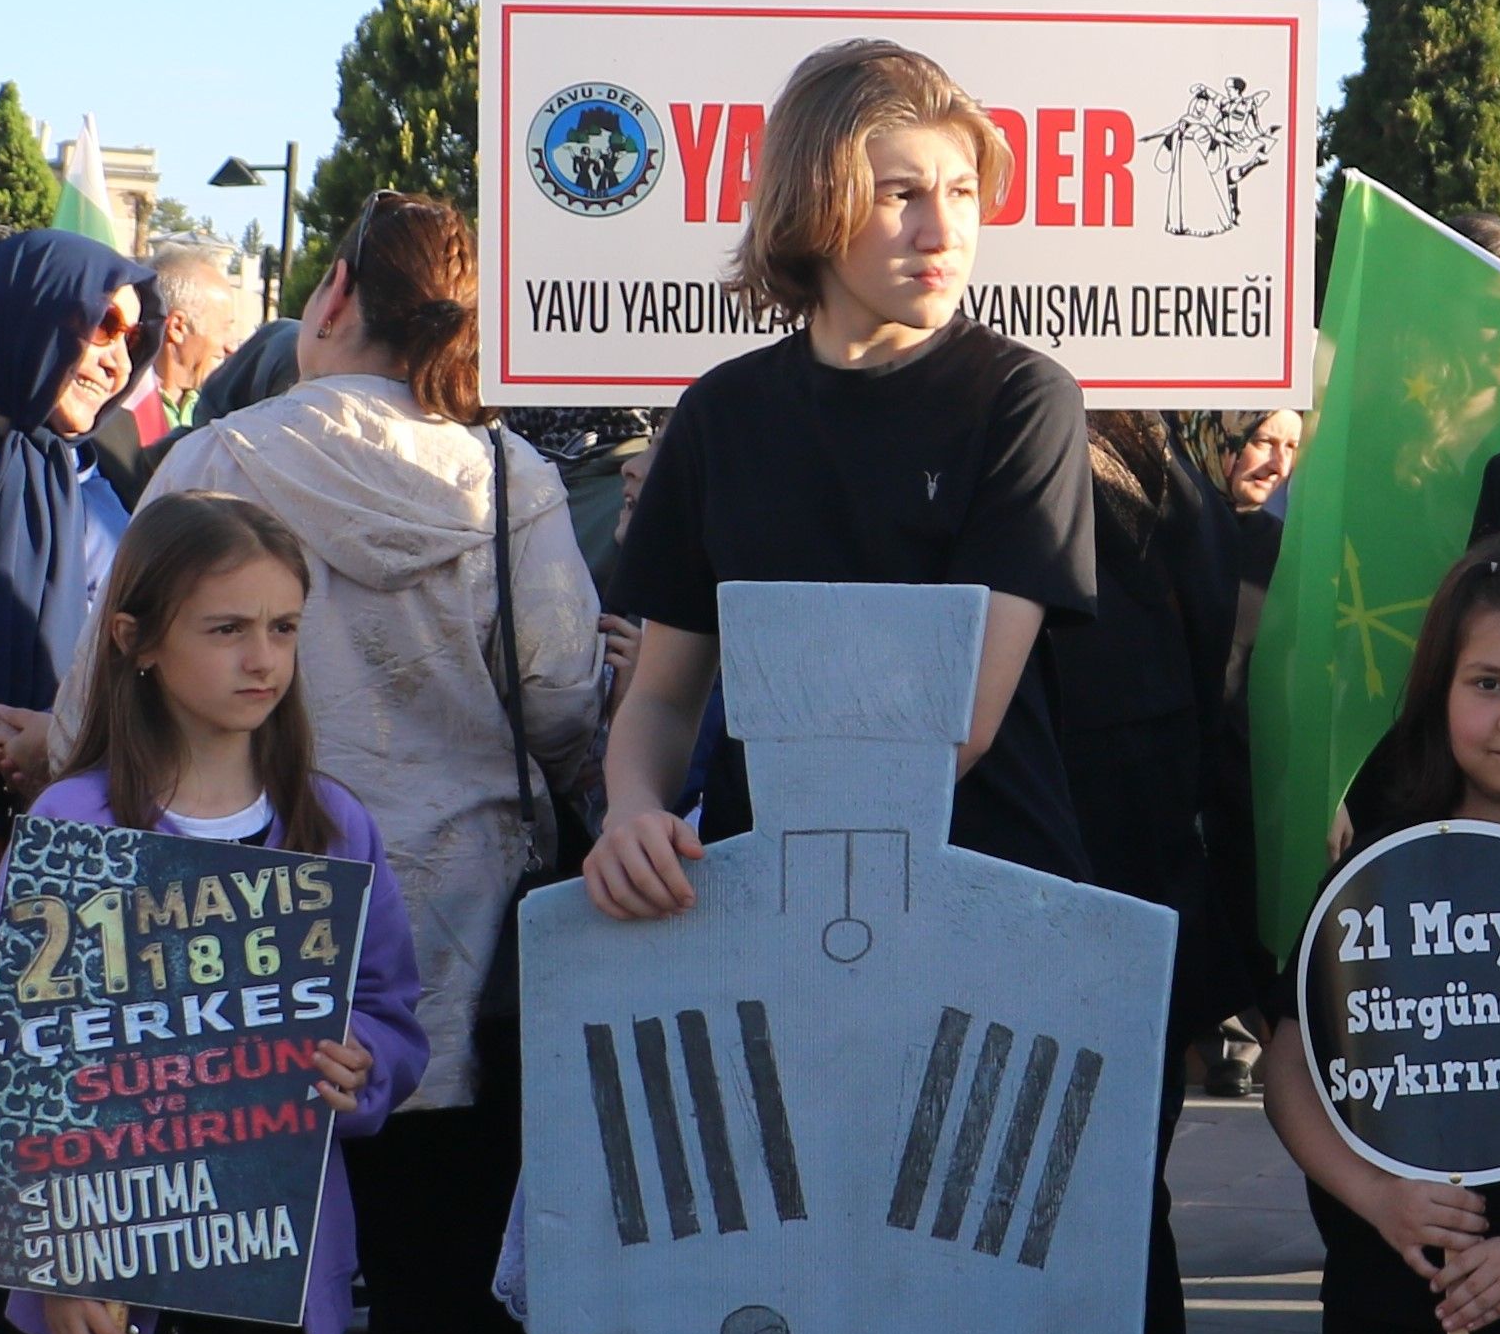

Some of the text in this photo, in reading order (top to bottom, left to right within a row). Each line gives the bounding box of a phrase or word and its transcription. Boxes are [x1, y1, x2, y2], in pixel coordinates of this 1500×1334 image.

[544, 87, 644, 116] YAVU-DER
[526, 279, 610, 334] YAVU
[959, 284, 1122, 348] YANIŞMA
[1130, 274, 1273, 338] DERNEĞİ
[10, 861, 334, 1003] 21 MAYIS
[137, 918, 340, 990] 1864
[1337, 904, 1392, 963] 21
[20, 975, 336, 1067] ÇERKES
[141, 1092, 188, 1117] ve
[52, 1159, 219, 1229] UNUTMA
[19, 1179, 58, 1287] ASLA
[57, 1204, 299, 1286] UNUTTURMA
